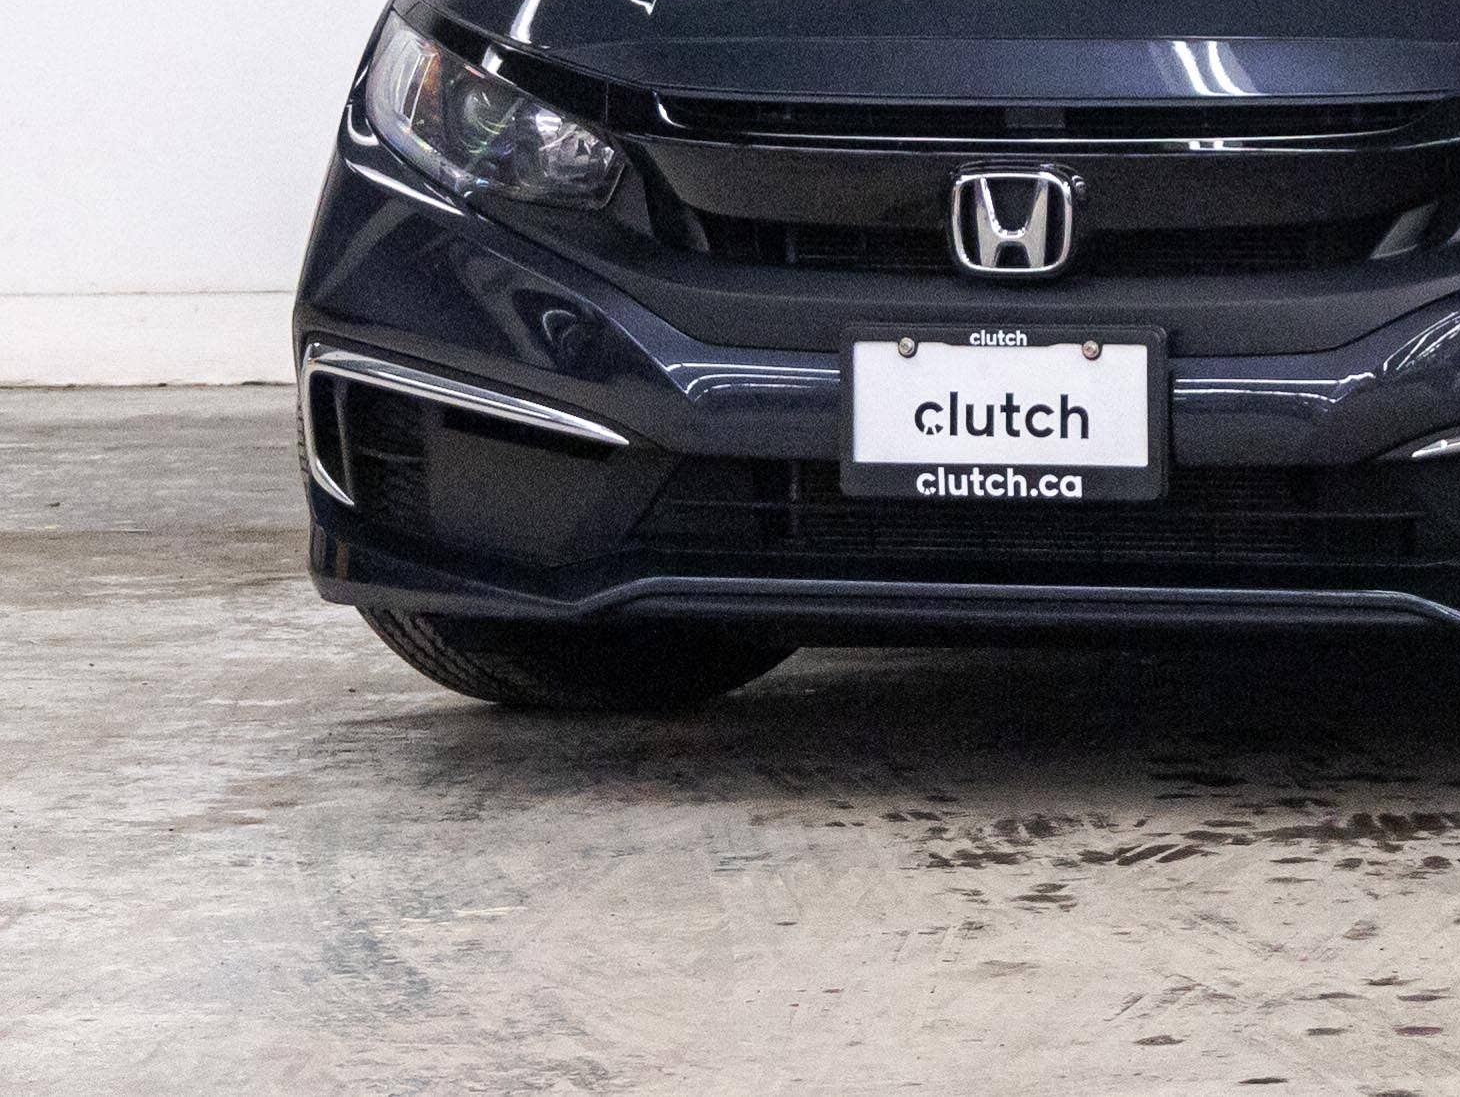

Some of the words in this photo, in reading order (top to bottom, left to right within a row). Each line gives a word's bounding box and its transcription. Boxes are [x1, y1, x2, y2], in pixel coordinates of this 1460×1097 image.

[969, 329, 1028, 346] clutch
[914, 391, 1089, 439] clutch
[916, 466, 1083, 498] clutch.ca
